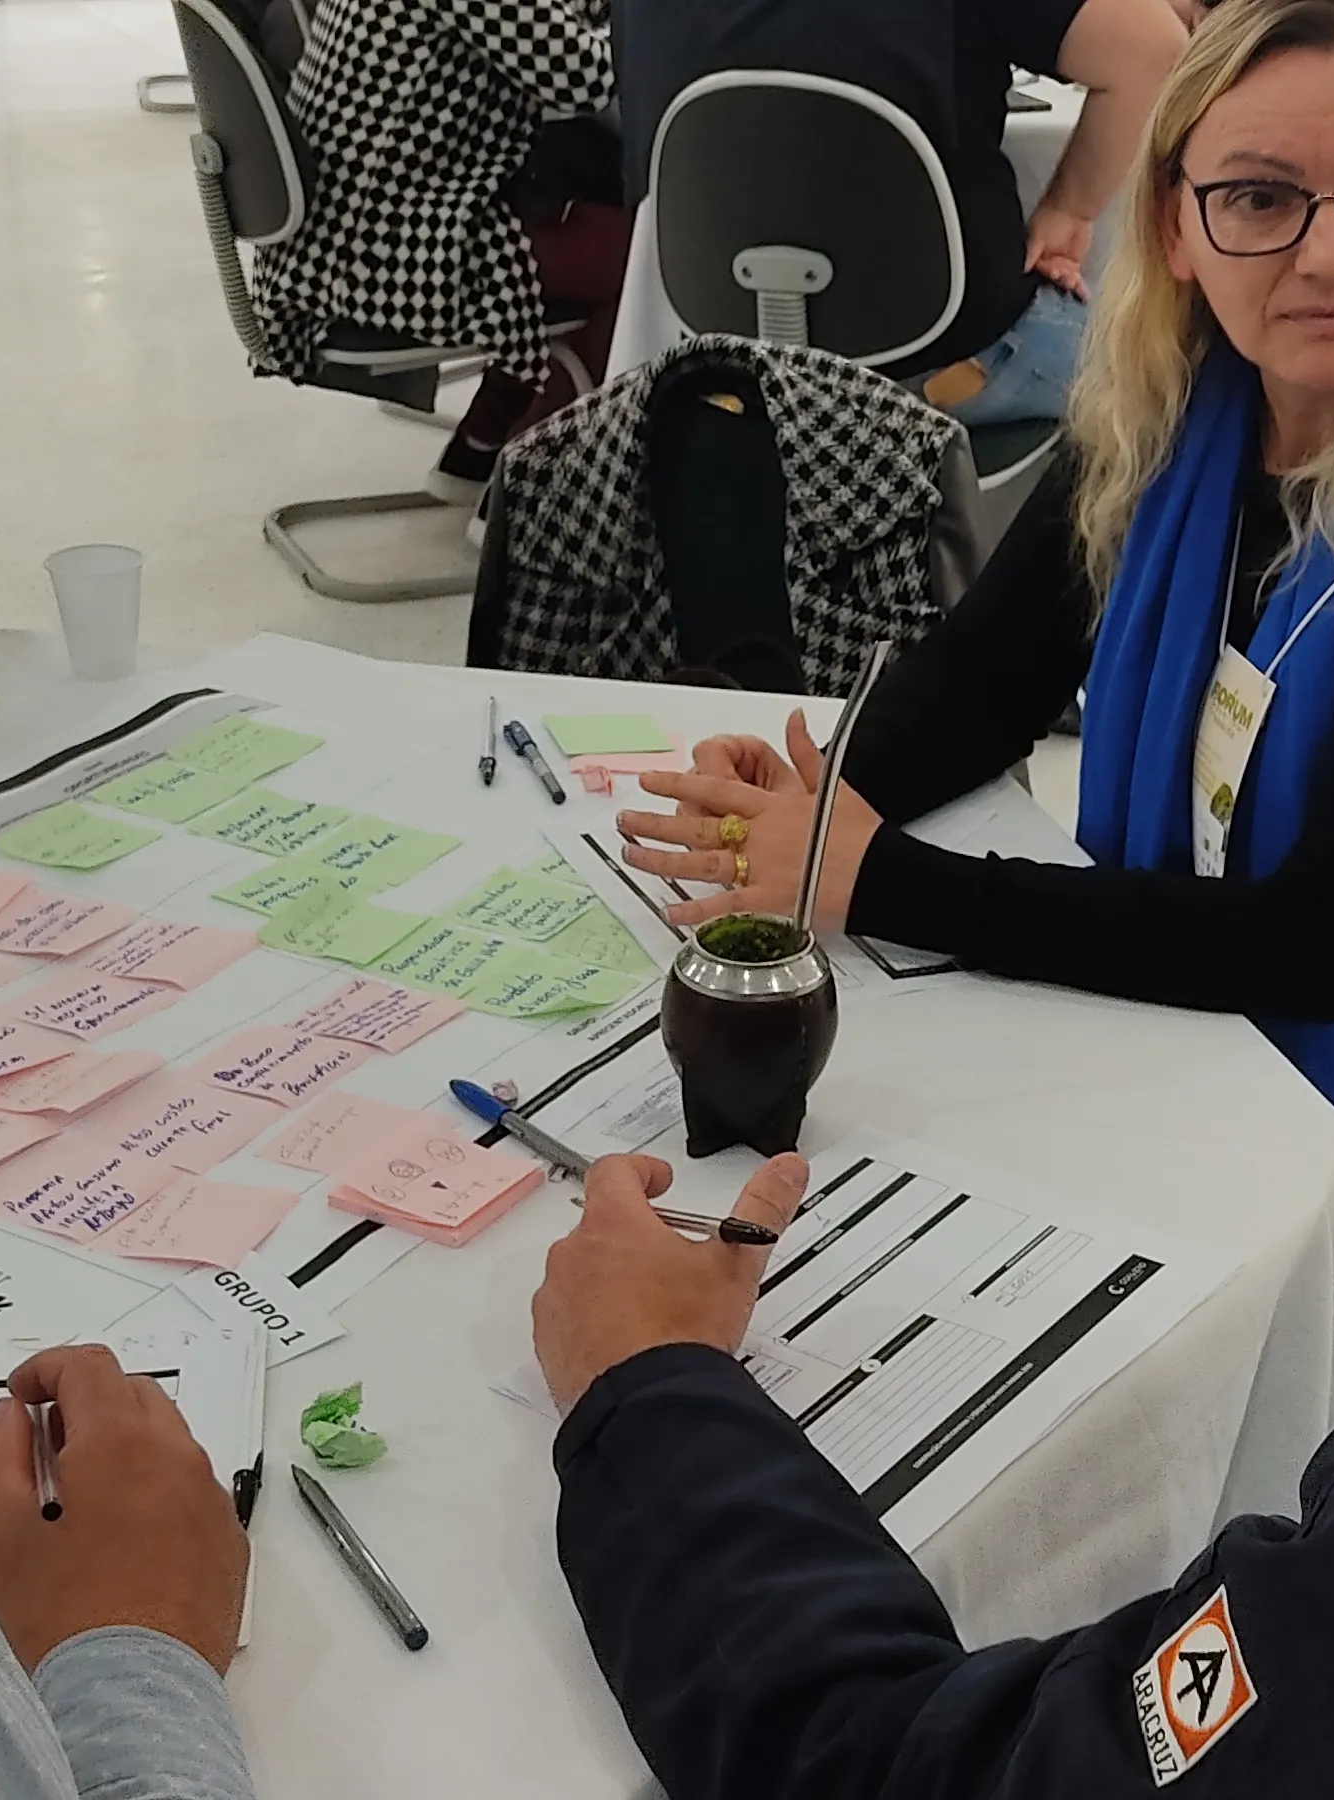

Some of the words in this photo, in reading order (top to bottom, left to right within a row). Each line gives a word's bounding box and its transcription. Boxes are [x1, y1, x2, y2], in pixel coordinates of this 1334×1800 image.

[214, 1271, 290, 1330] GRUPO
[280, 1331, 306, 1346] 1
[1134, 1669, 1178, 1781] ARACRUZ
